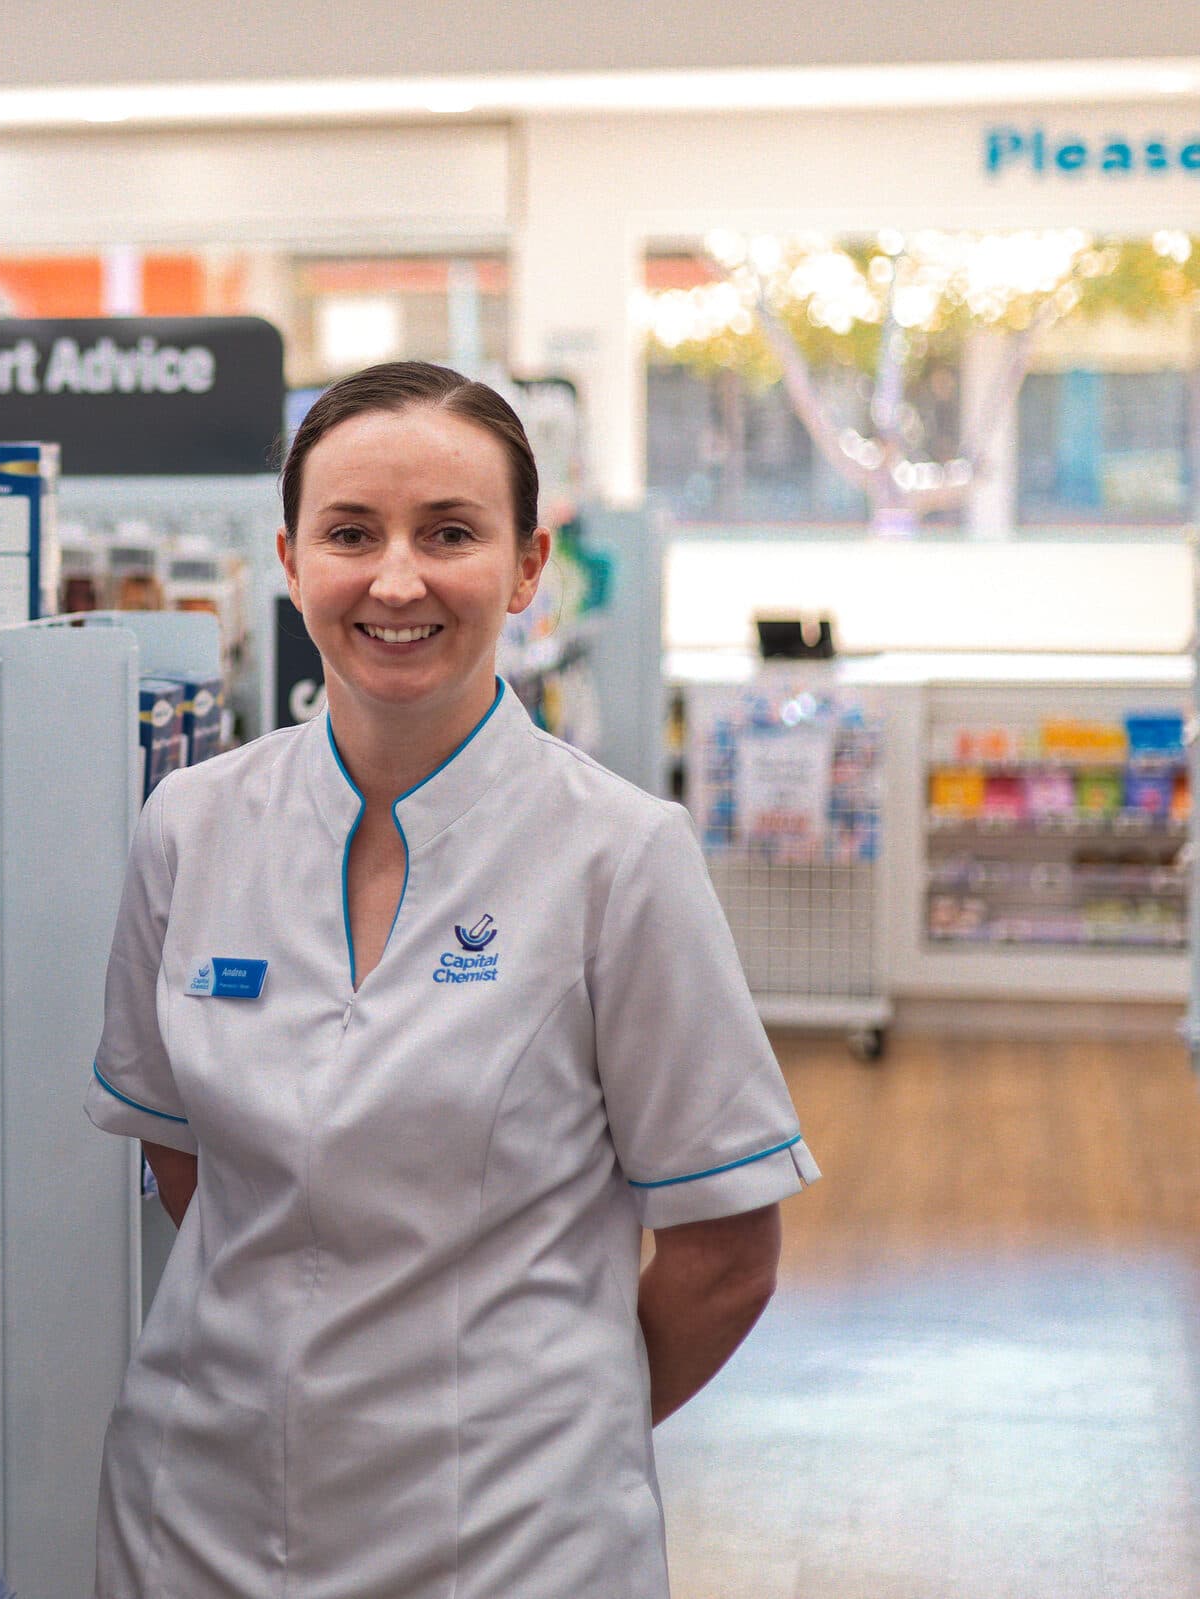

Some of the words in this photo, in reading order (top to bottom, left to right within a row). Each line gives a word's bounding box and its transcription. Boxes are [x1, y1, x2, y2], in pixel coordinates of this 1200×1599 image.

[44, 336, 216, 393] Advice
[440, 952, 499, 970] Capital
[221, 968, 247, 977] Andrea
[432, 968, 499, 984] Chemist
